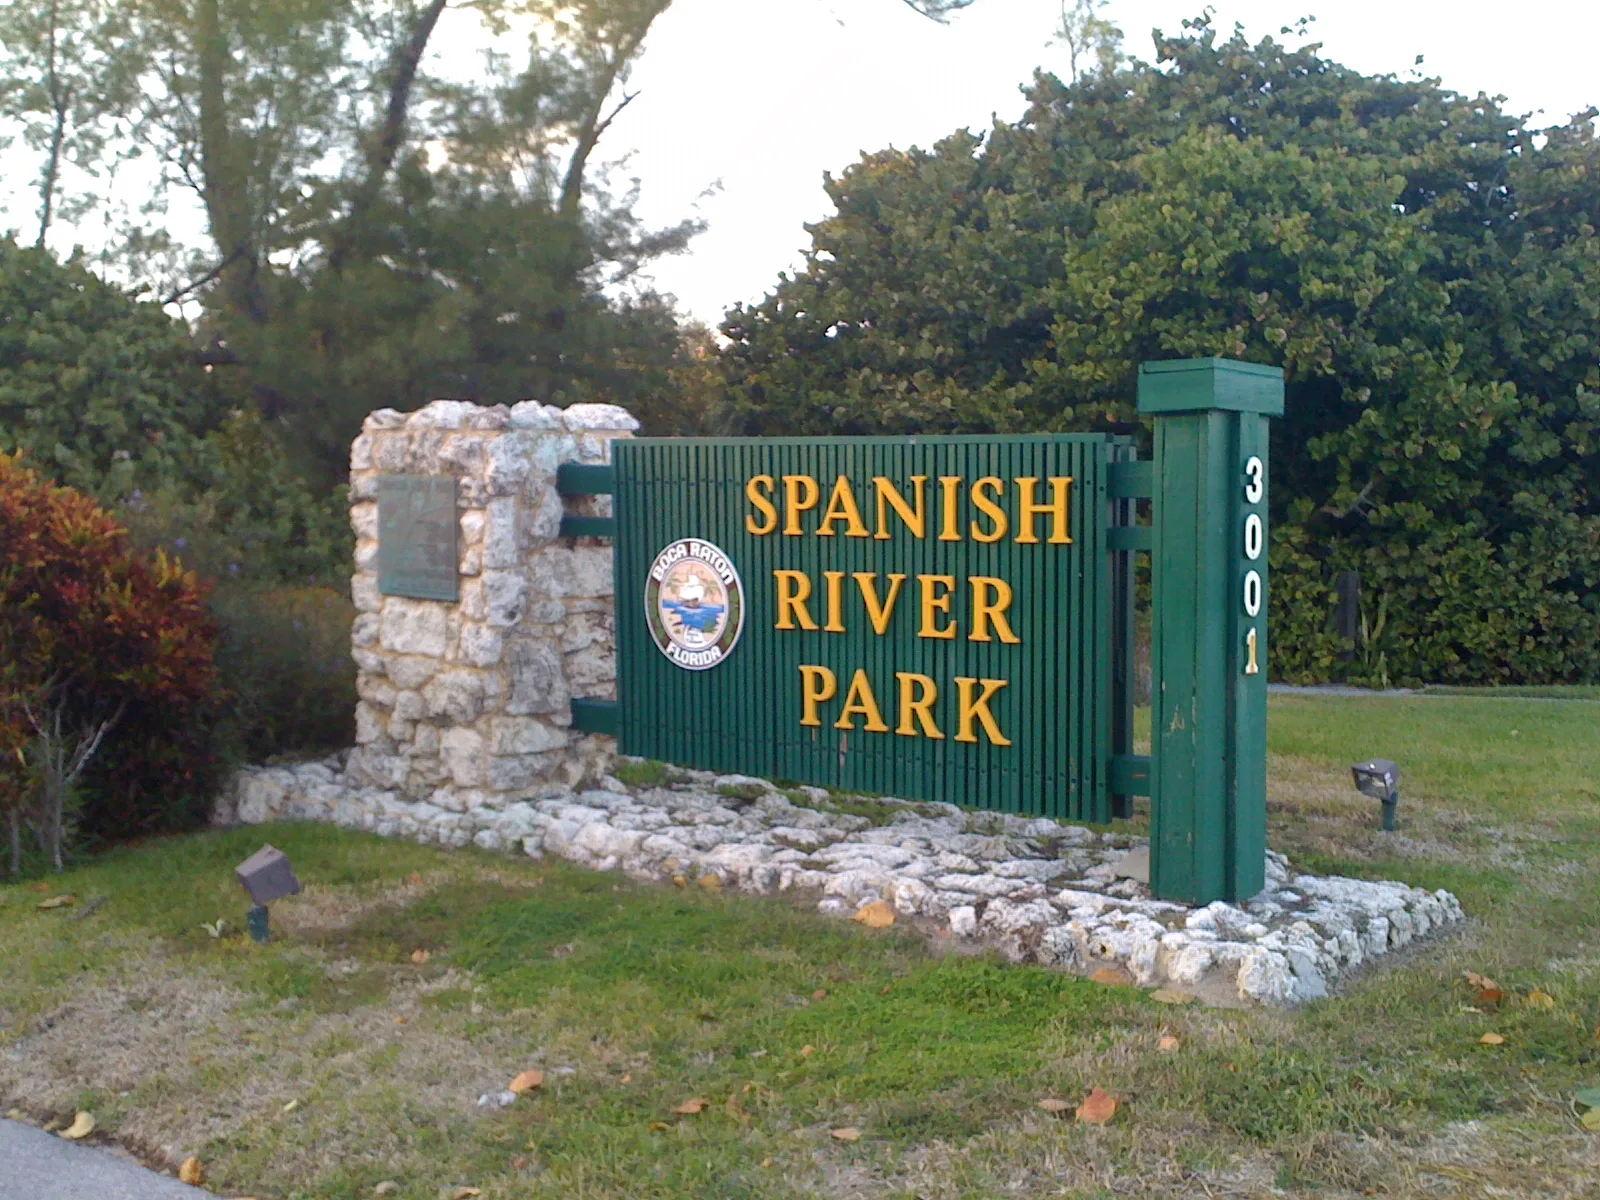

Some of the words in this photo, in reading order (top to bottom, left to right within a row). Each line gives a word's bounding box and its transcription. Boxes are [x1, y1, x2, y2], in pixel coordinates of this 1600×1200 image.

[745, 475, 1073, 544] SPANISH
[651, 543, 687, 582] BOCA
[690, 542, 735, 585] RATON
[1244, 456, 1262, 673] 3001
[773, 570, 1020, 643] RIVER
[666, 641, 722, 666] FLORIDA
[798, 665, 1011, 746] PARK
